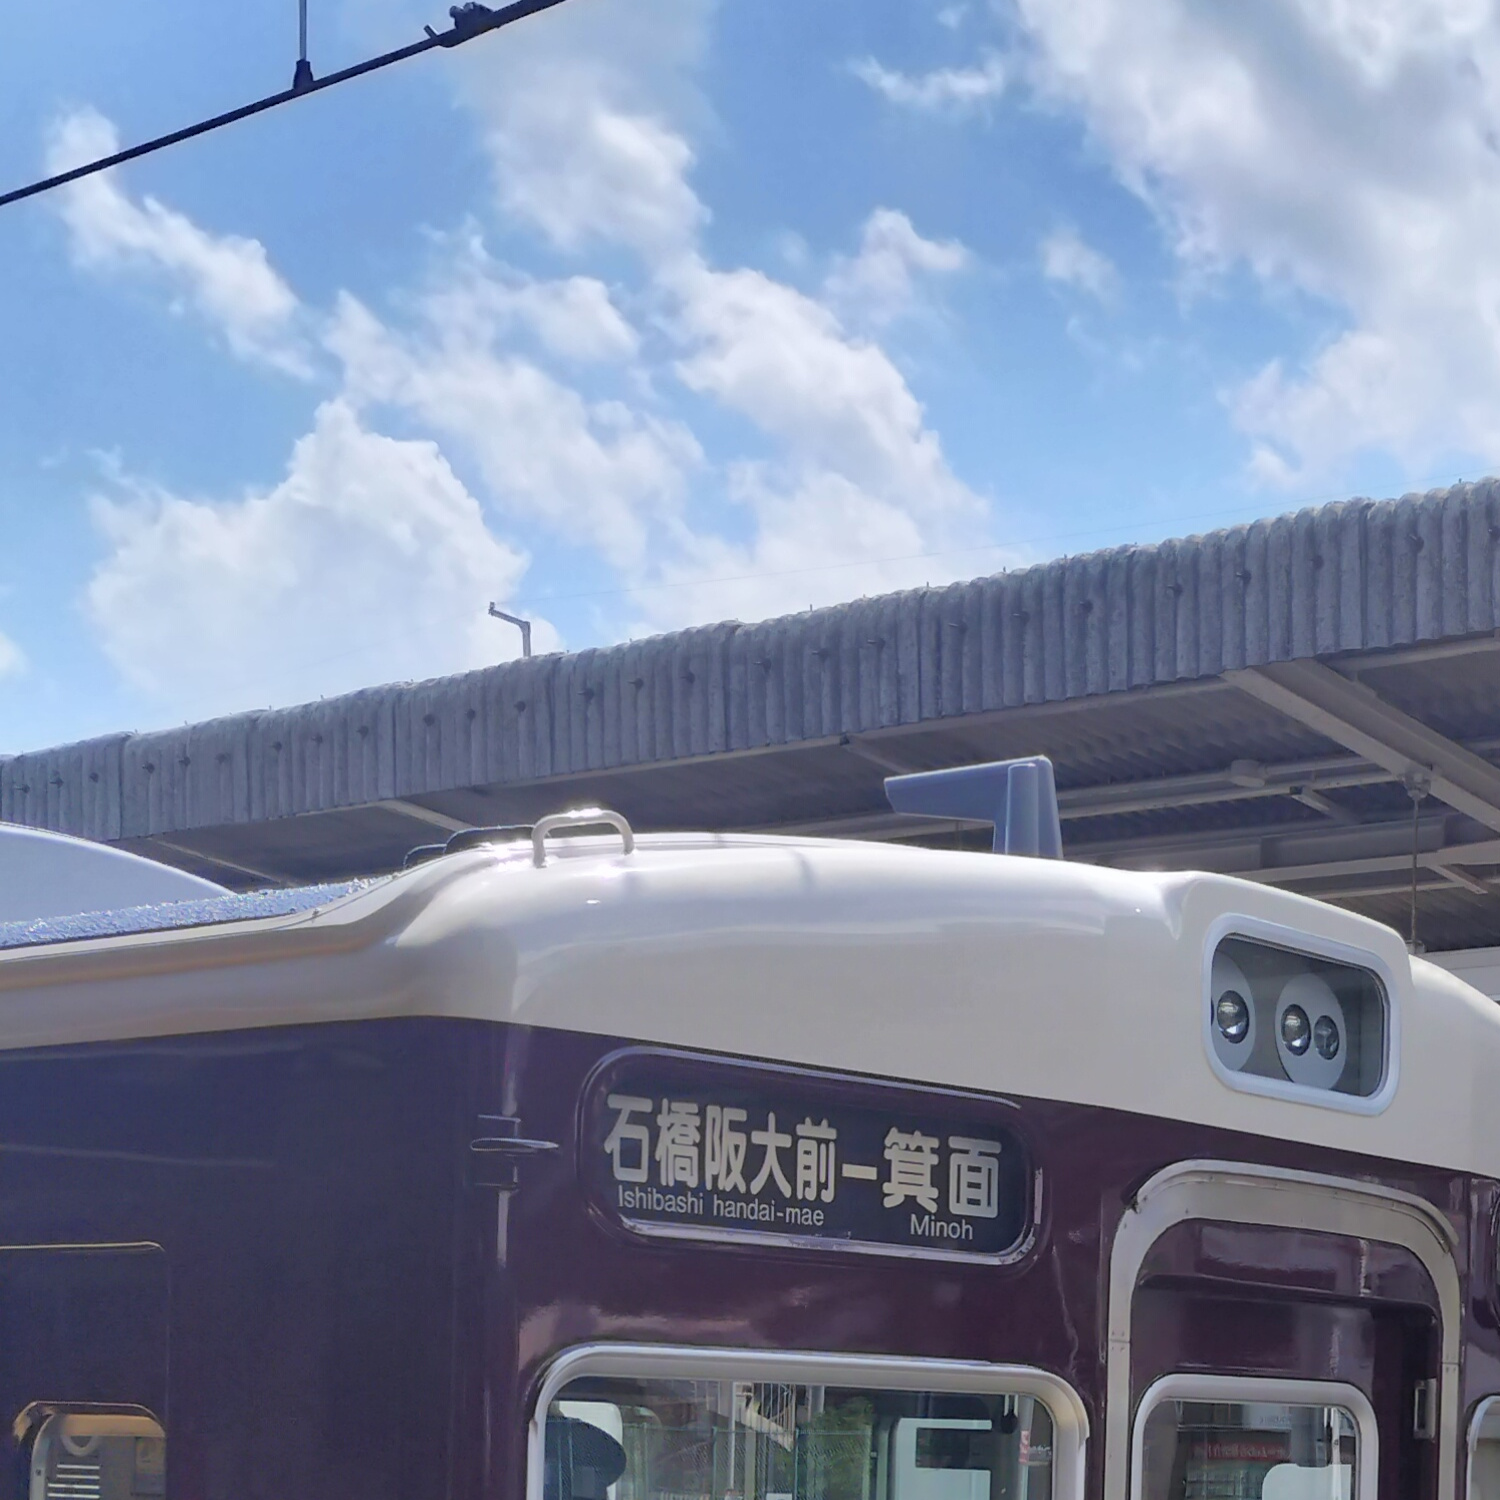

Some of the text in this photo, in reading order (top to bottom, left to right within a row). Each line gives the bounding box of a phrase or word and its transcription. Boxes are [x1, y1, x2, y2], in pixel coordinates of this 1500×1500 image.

[617, 1184, 825, 1227] Ishibashi handai-mae
[910, 1213, 974, 1240] Minoh
